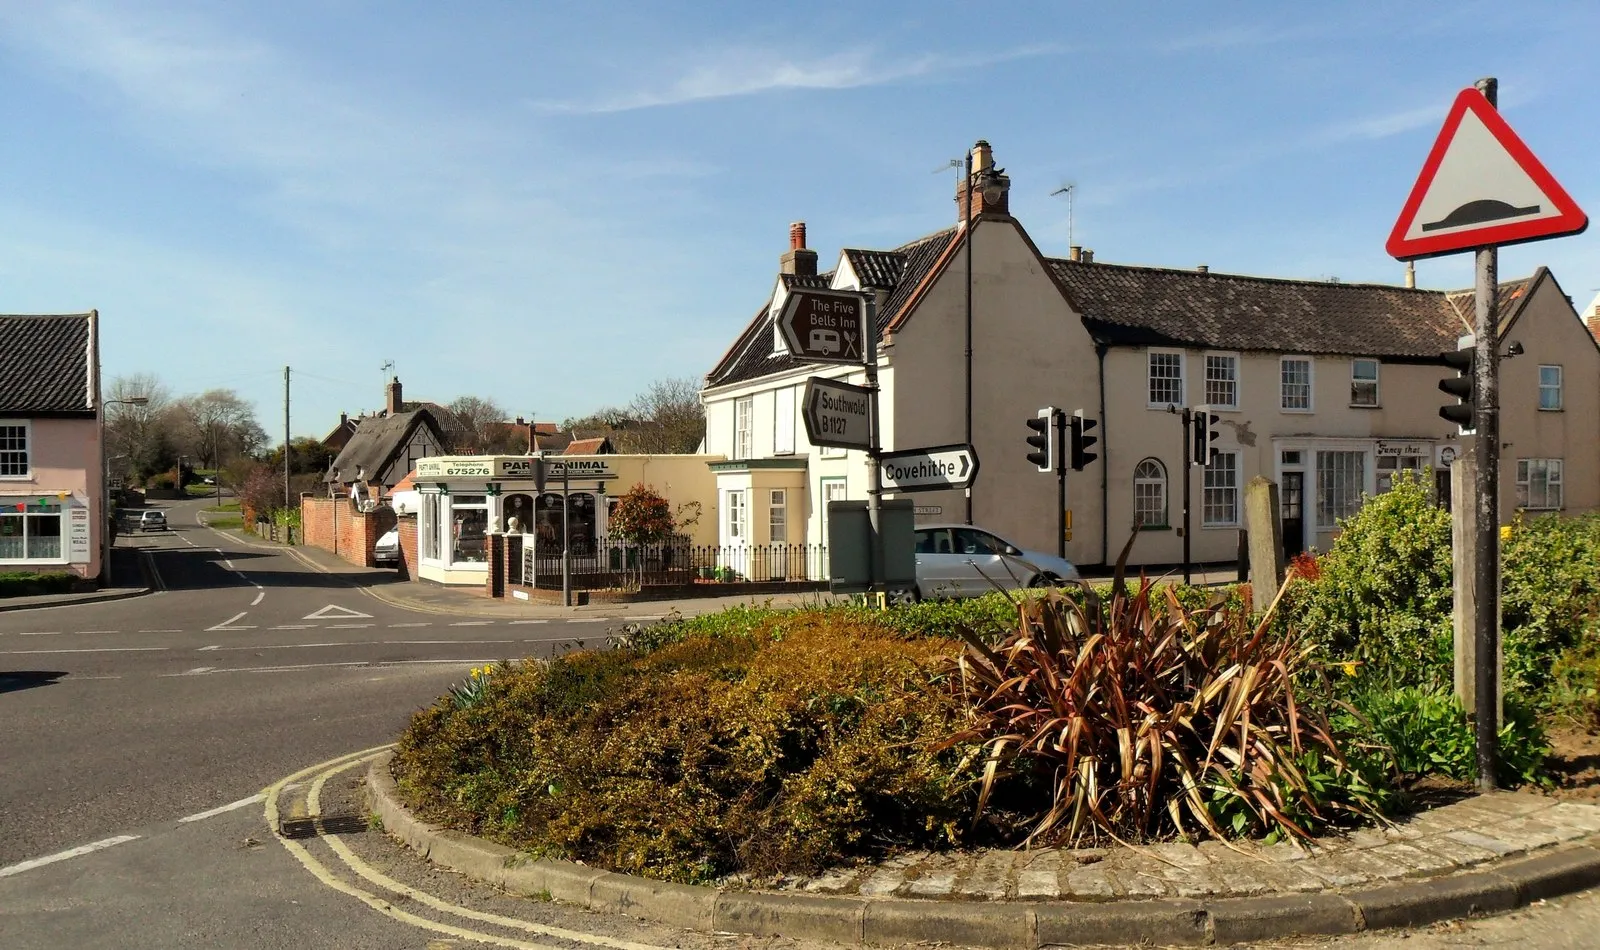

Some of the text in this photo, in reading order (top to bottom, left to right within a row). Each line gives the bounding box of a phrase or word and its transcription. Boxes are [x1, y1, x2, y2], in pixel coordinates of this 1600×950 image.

[811, 299, 854, 314] The Five
[810, 313, 856, 328] Bells Inn
[822, 391, 866, 416] Southwold
[1376, 440, 1402, 455] Fancy
[502, 461, 609, 470] PAR ANIMAL
[885, 459, 955, 480] Covehithe
